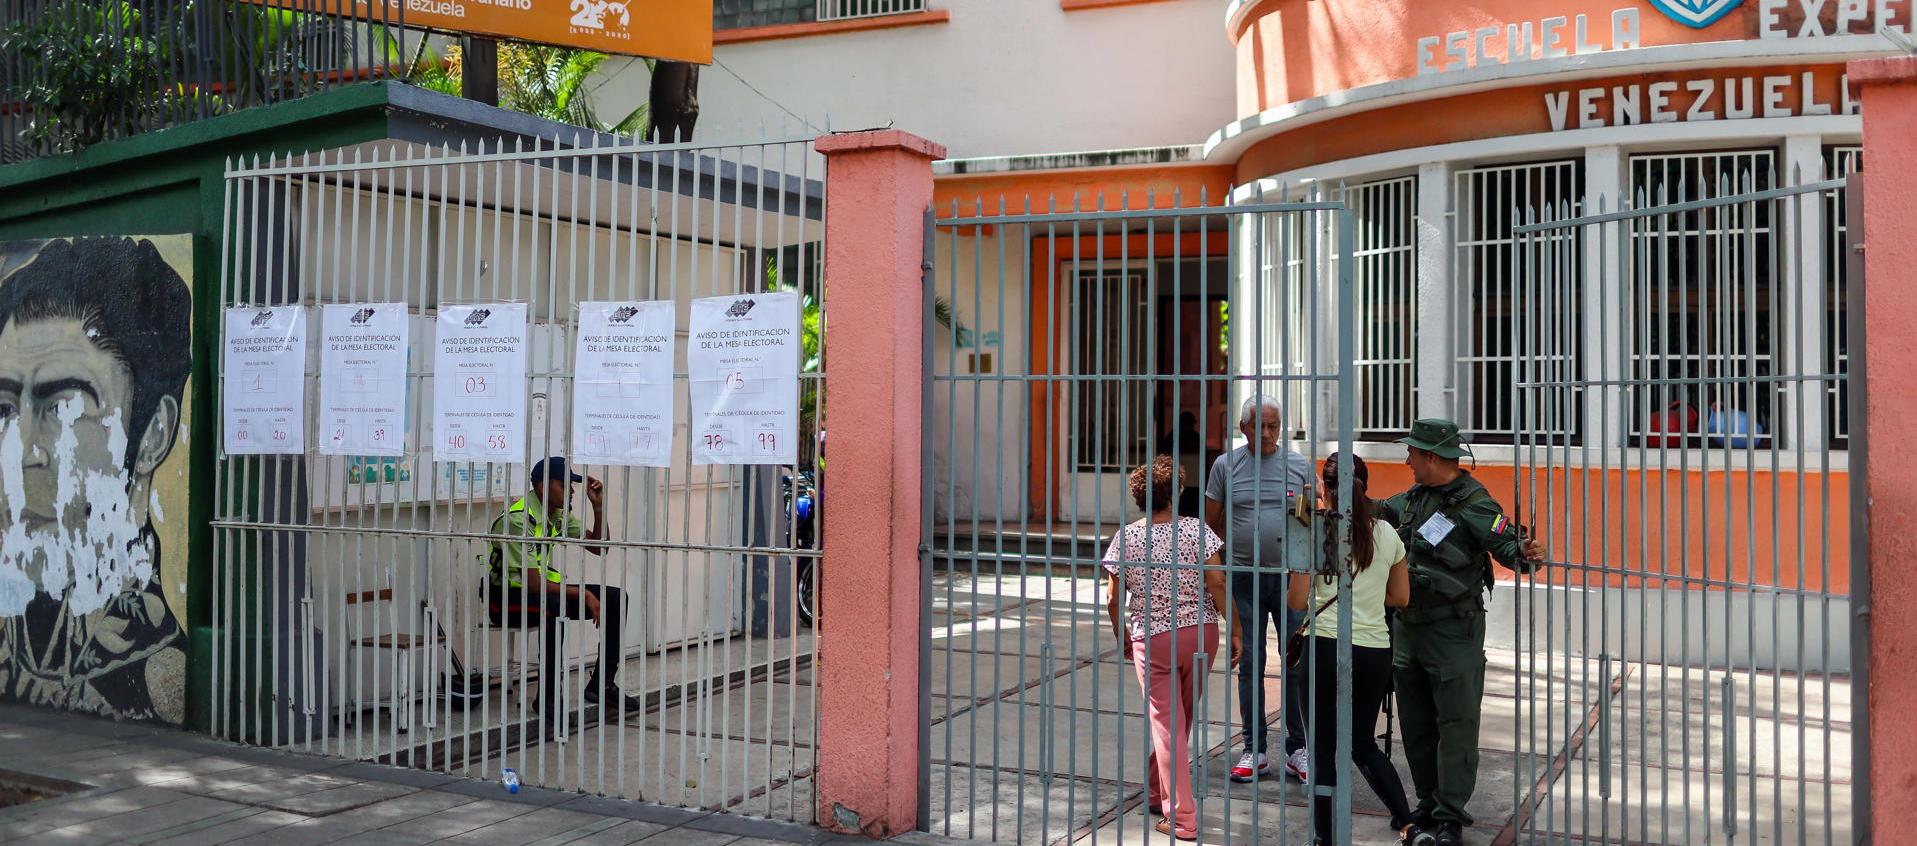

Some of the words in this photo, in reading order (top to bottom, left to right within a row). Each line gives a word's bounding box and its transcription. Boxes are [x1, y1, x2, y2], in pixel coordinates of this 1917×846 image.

[380, 0, 465, 18] enezuela
[1759, 0, 1917, 39] EXPE
[1417, 7, 1642, 76] ESCUELA
[701, 341, 711, 349] DE
[743, 338, 785, 347] ELECTORAL
[466, 377, 486, 394] 03
[449, 435, 465, 448] 40
[489, 434, 506, 449] 58
[704, 434, 724, 451] 78
[758, 433, 776, 451] 99
